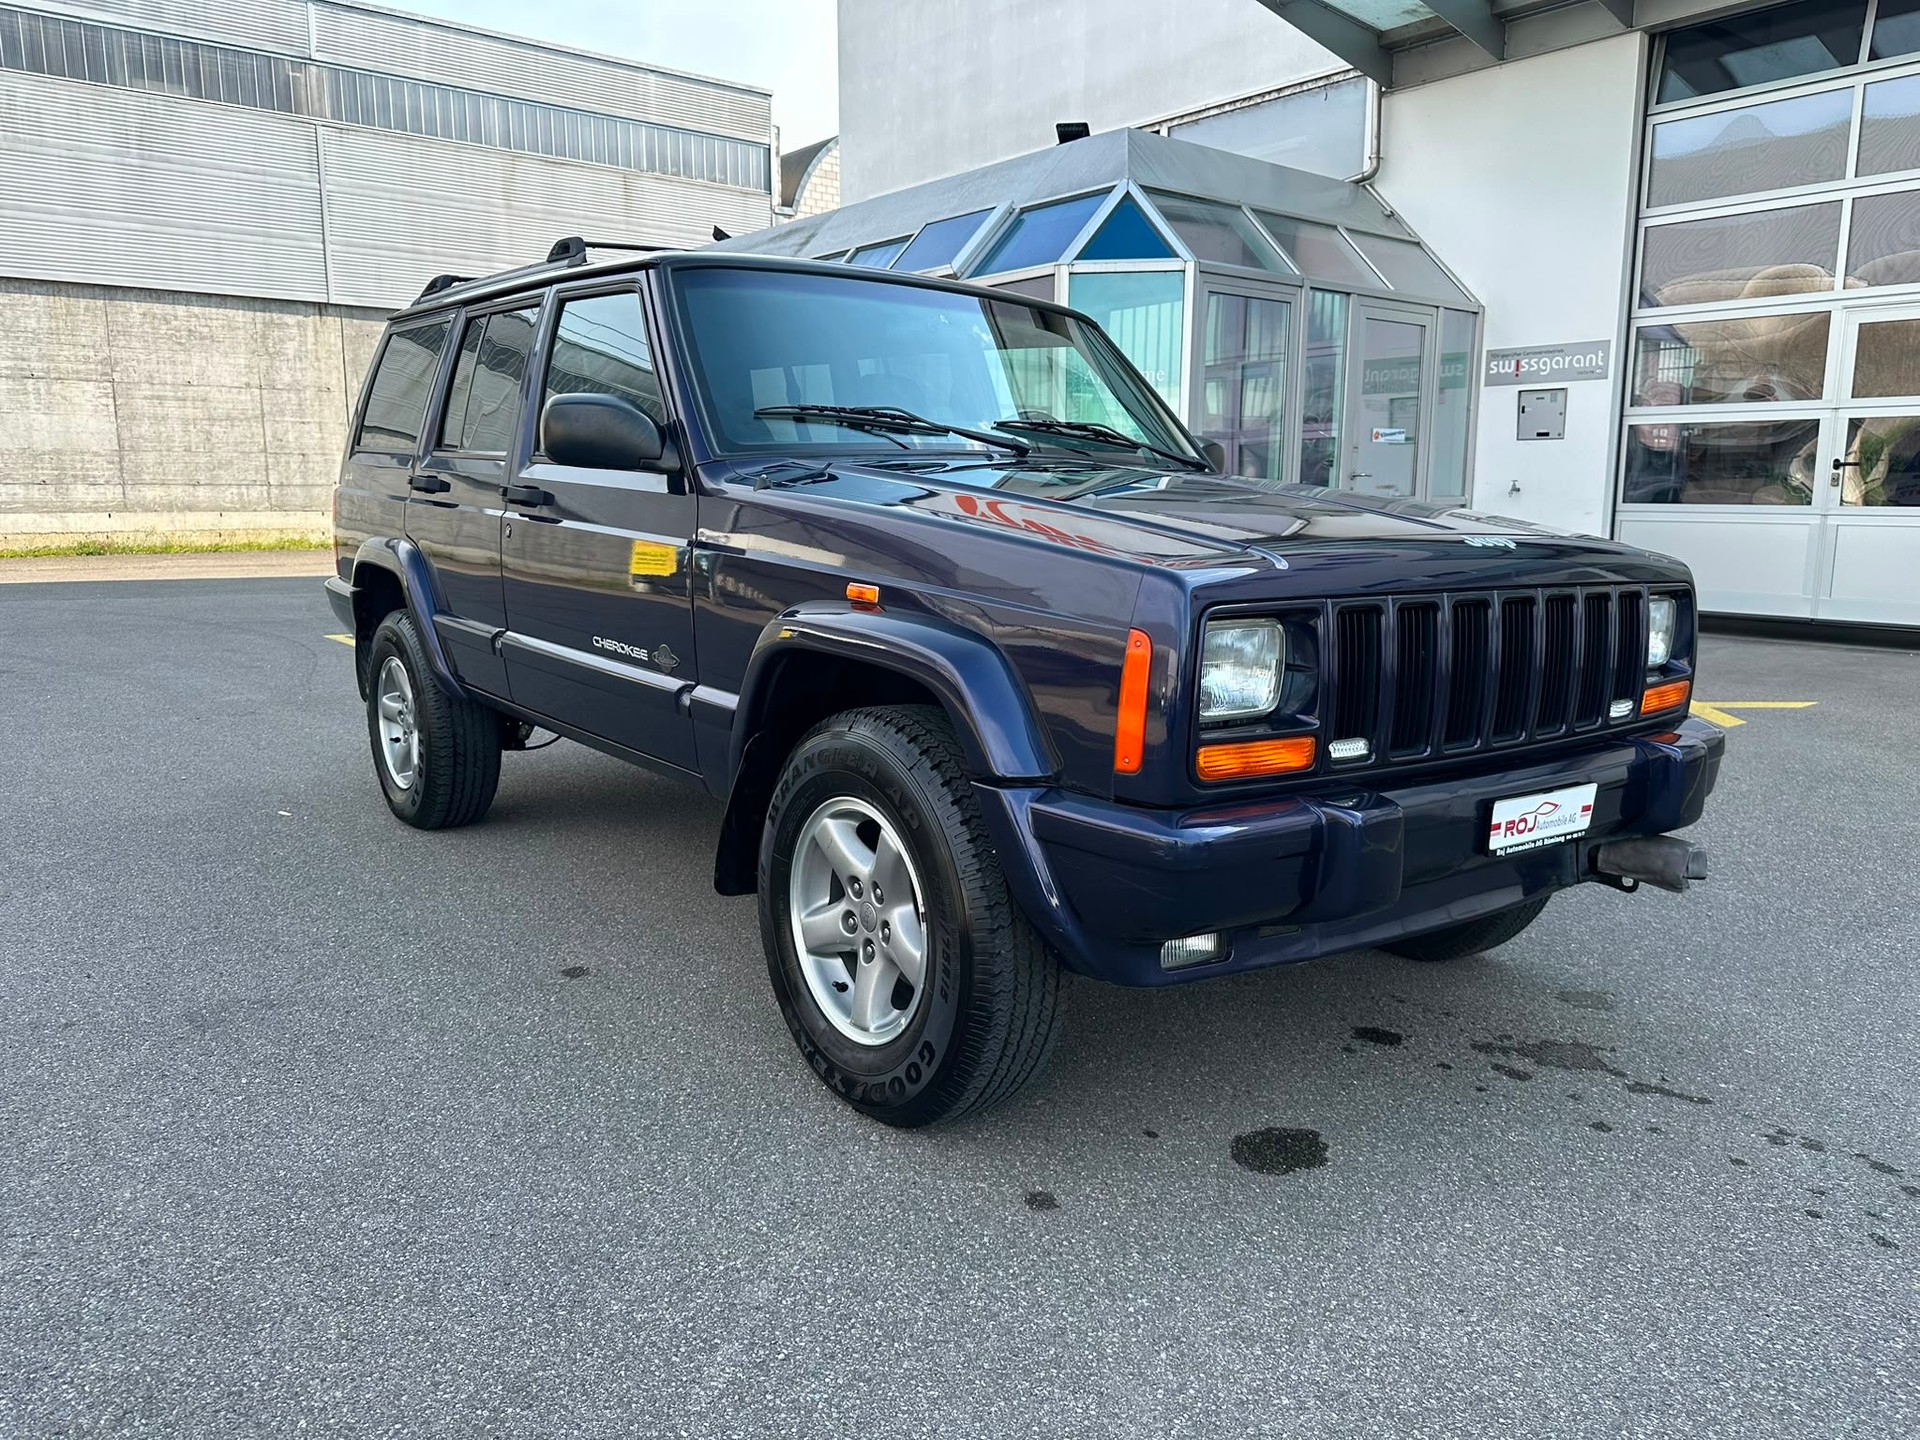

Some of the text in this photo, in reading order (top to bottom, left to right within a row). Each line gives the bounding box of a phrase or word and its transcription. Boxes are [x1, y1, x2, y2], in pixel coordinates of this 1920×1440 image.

[1460, 535, 1517, 550] Jeep
[592, 635, 648, 661] CHEROKEE
[1504, 814, 1537, 838] ROJ
[1567, 812, 1577, 825] AG
[1496, 848, 1506, 857] Roj
[1506, 841, 1535, 854] Automobile
[1535, 838, 1543, 848] AG
